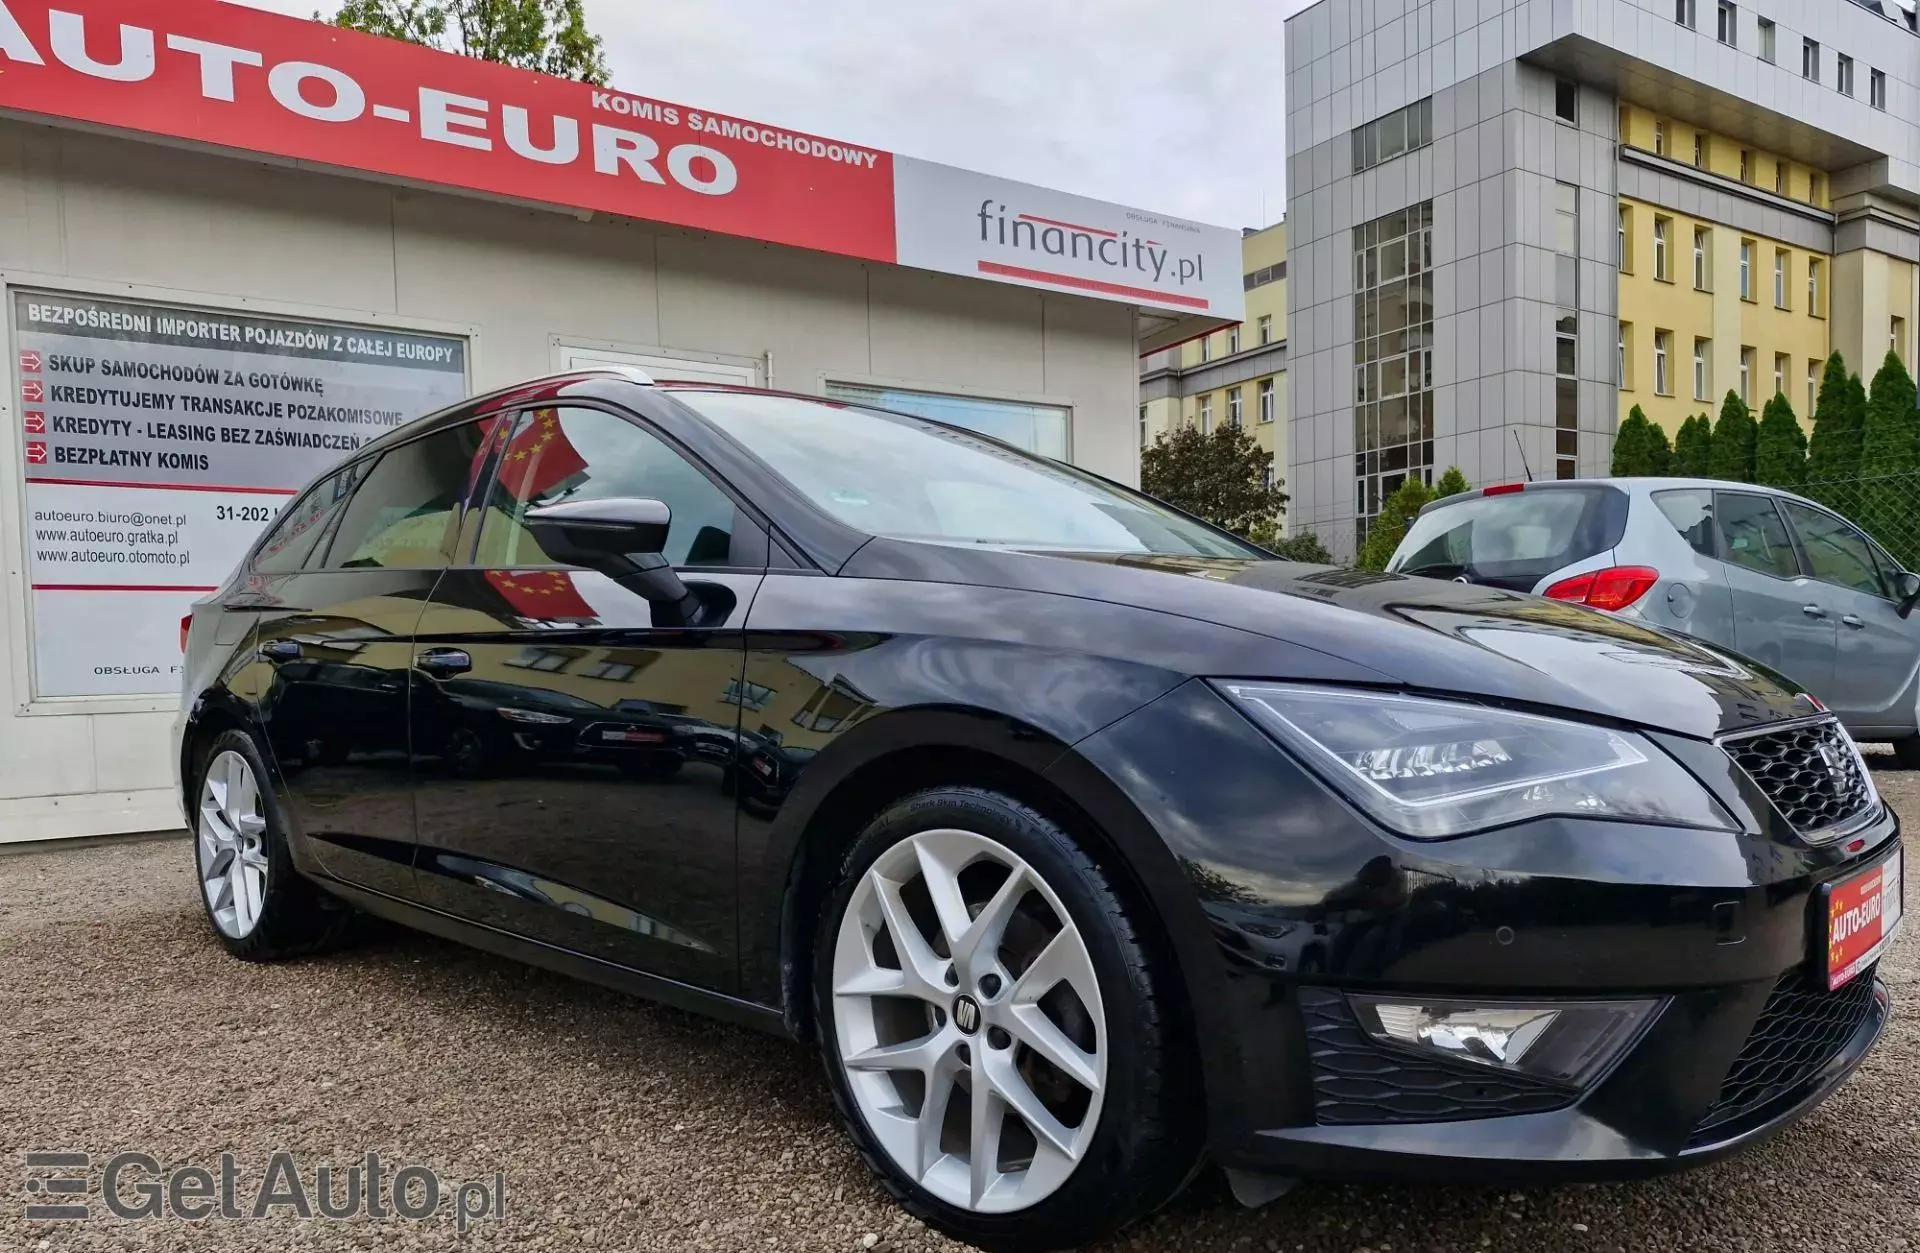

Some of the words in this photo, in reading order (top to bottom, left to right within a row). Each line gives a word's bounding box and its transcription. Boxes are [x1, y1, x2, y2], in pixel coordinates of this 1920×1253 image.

[592, 91, 679, 126] KOMIS
[688, 112, 878, 169] SAMOCHODOWY
[977, 200, 1204, 285] financity.pl
[28, 303, 151, 333] BEZPOŚREDNI
[156, 317, 241, 342] IMPORTER
[245, 326, 329, 351] POJAZDÓW
[333, 336, 343, 352] Z
[347, 337, 392, 357] CAŁEJ
[396, 342, 453, 363] EUROPY
[49, 354, 96, 374] SKUP
[101, 359, 219, 385] SAMOCHODÓW
[223, 370, 245, 387] ZA
[249, 371, 324, 397] GOTÓWKĘ
[50, 385, 176, 410] KREDYTUJEMY
[180, 395, 282, 418] TRANSAKCJE
[287, 403, 403, 426] POZAKOMISOWE
[53, 416, 132, 437] KREDYTY
[147, 422, 216, 442] LEASING
[221, 427, 250, 444] BEZ
[254, 427, 360, 450] ZAŚWIADCZEŃ
[55, 446, 152, 467] BEZPŁATNY
[157, 452, 209, 470] KOMIS
[34, 510, 186, 526] autoeuro.biuro@onet.pl
[216, 505, 269, 522] 31-202
[35, 529, 178, 547] www.autoeuro.gratka.pl
[37, 548, 190, 567] www.autoeuro.otomoto.pl
[94, 666, 160, 675] OBSŁUGA
[1833, 893, 1881, 945] AUTO-EURO
